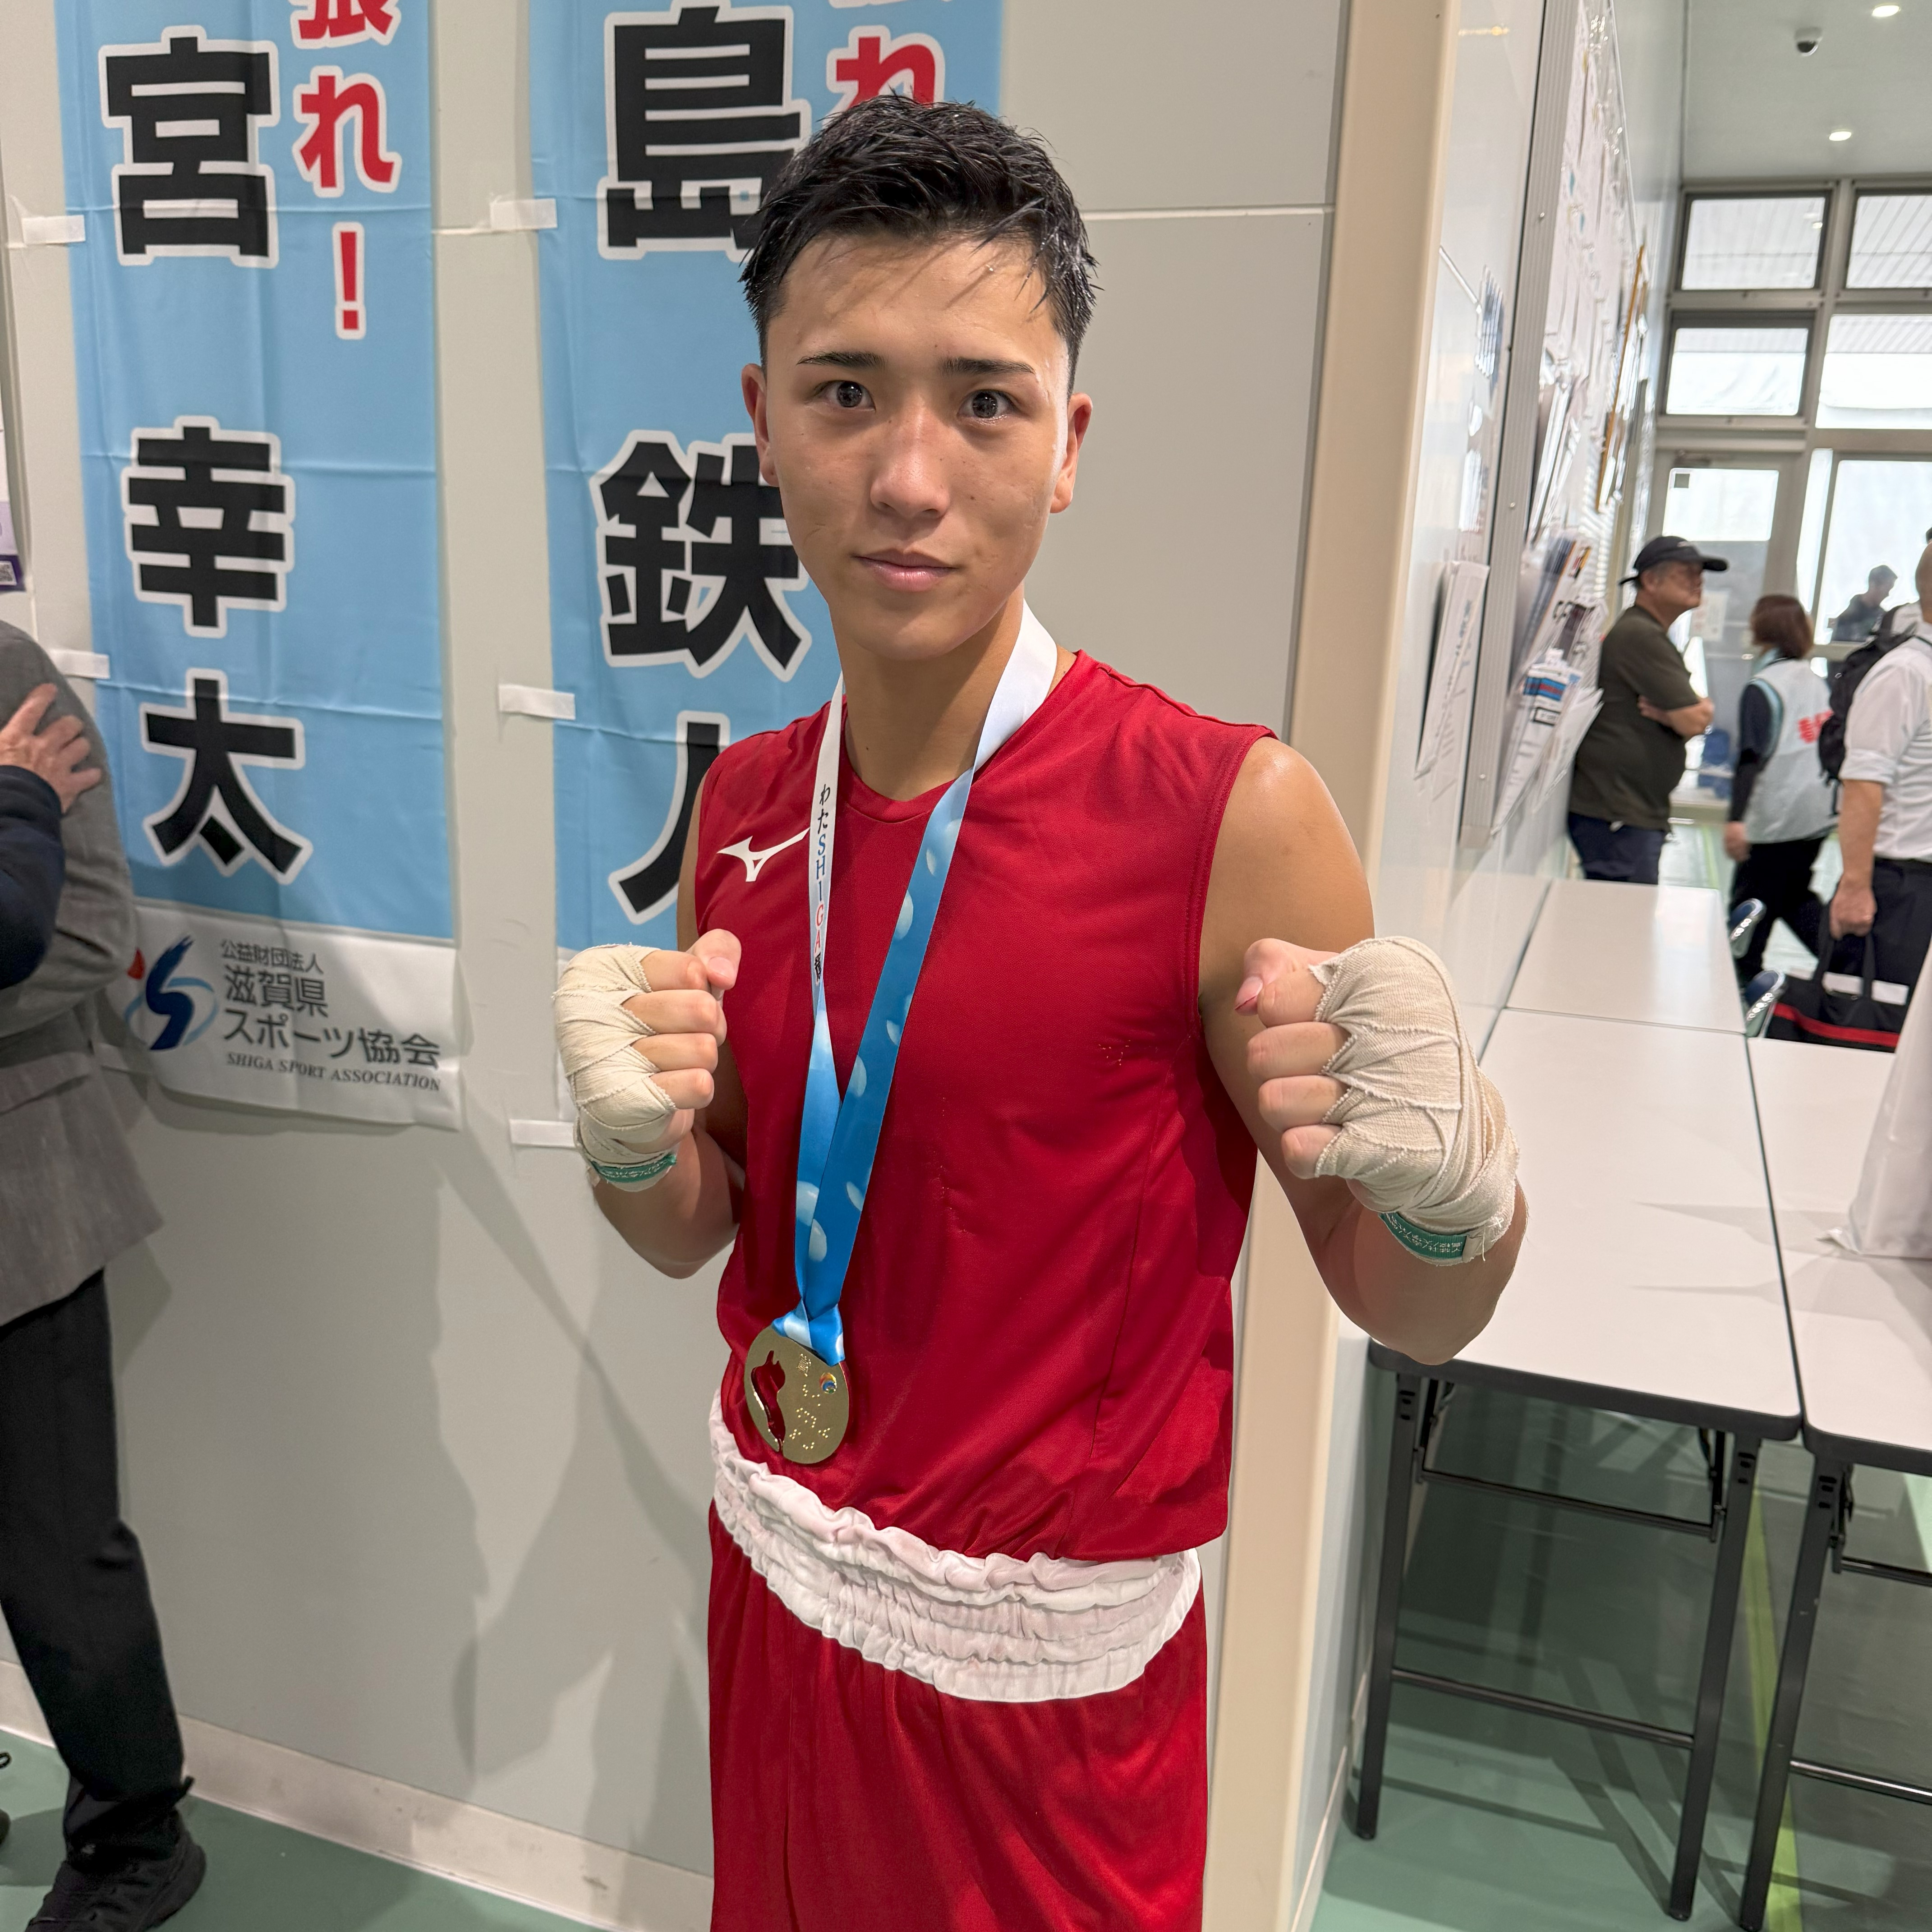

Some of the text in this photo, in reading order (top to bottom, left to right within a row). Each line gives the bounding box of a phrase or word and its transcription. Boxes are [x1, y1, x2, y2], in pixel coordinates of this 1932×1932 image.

[106, 37, 303, 874] 宮 幸太
[221, 939, 324, 974] 公益財団法人
[224, 964, 328, 1018] 滋賀県
[224, 1008, 440, 1068] スポーツ協会
[227, 1051, 441, 1091] SHIGA SPORT ASSOCIATION
